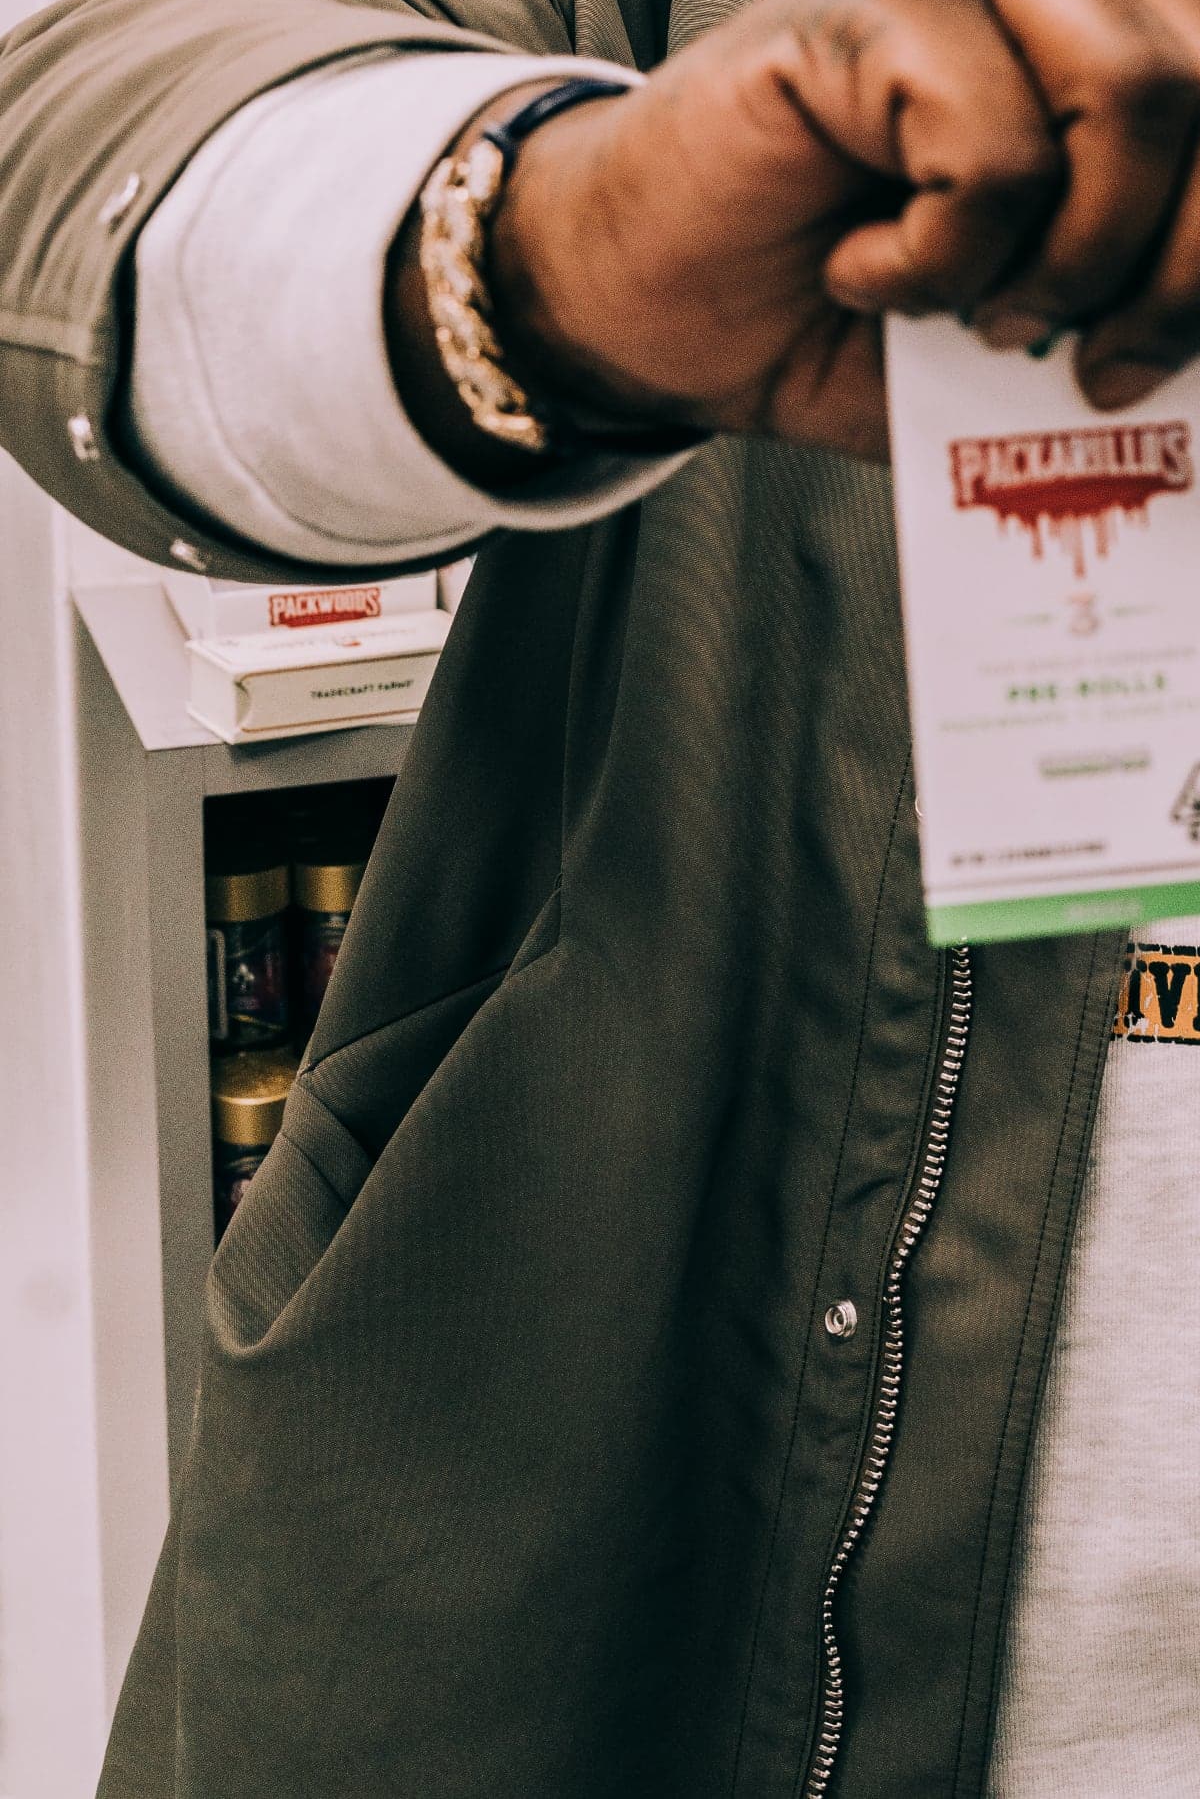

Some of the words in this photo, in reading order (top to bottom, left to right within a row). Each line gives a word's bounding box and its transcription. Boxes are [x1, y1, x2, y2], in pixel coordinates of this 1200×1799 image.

[950, 422, 1193, 509] PACKARILLOS
[271, 588, 380, 628] PACKWOODS
[1064, 589, 1102, 638] 3
[310, 685, 374, 699] TRADECRAFT
[1007, 671, 1168, 702] PRE-ROLLS
